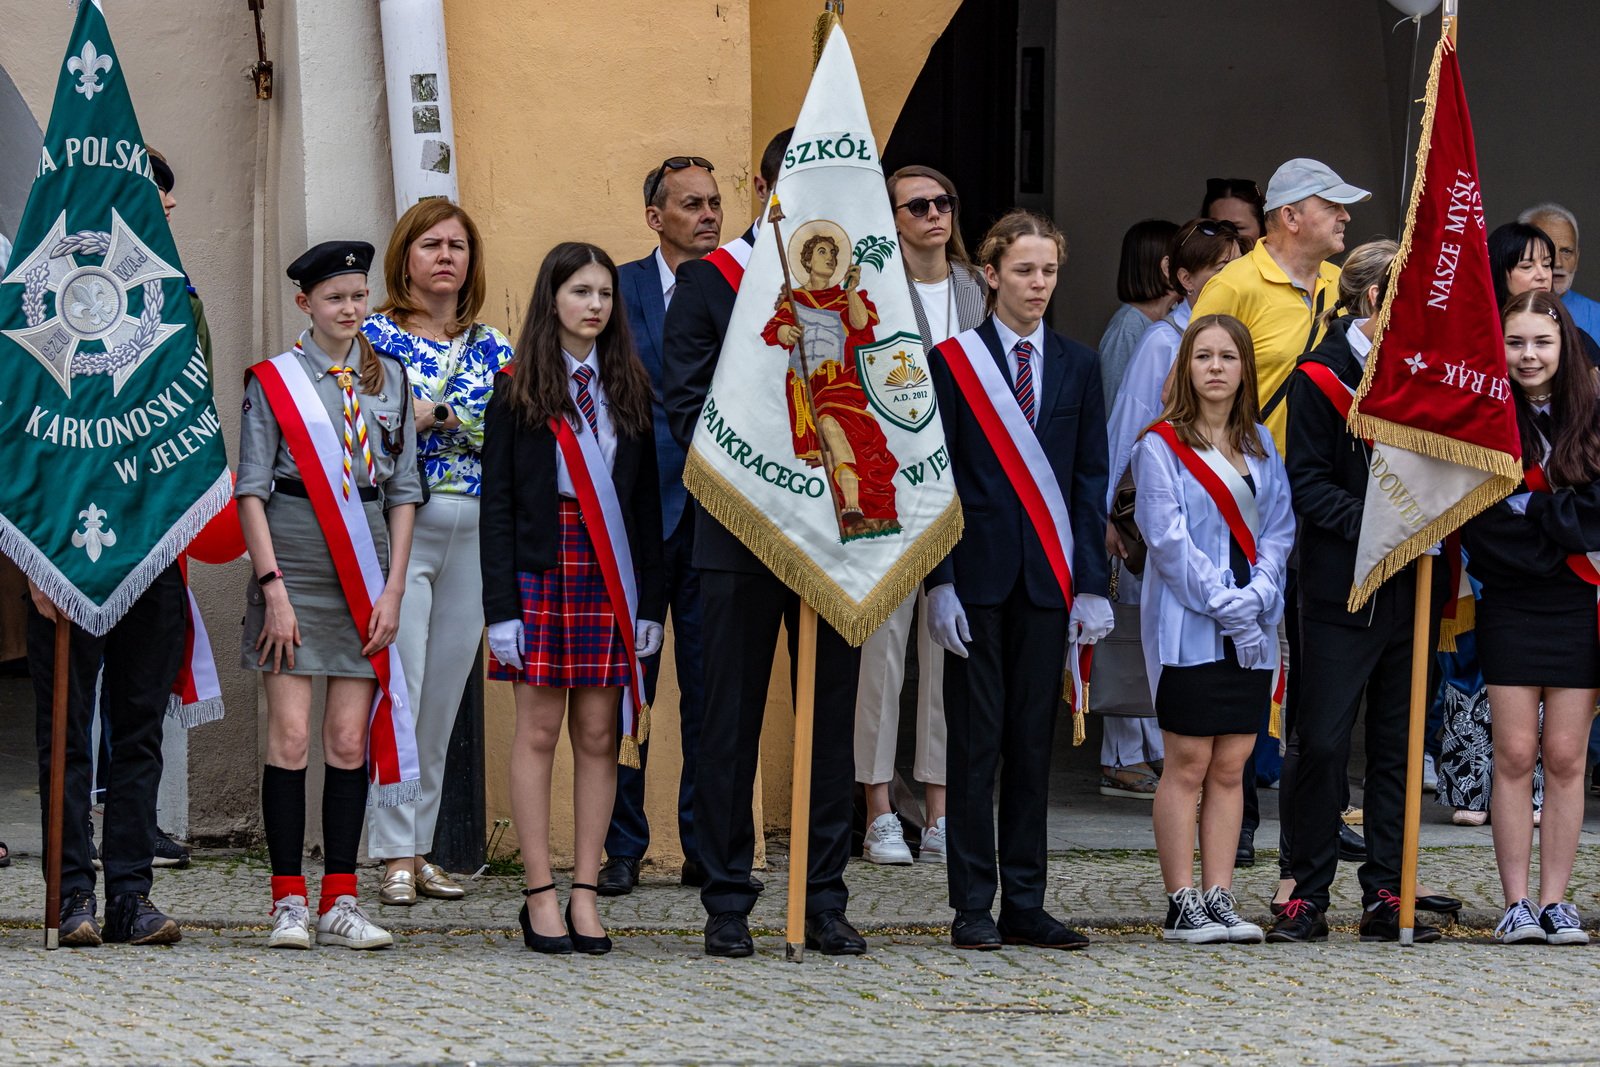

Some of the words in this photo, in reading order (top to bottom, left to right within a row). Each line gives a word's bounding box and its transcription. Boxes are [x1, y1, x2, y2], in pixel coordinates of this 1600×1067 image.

[784, 132, 872, 170] SZKÓŁ
[113, 246, 148, 281] WAJ
[1426, 241, 1462, 311] NASZE
[41, 328, 70, 361] CZU
[1439, 359, 1487, 394] RĄK
[893, 393, 911, 403] A.D.
[912, 390, 928, 400] 2012
[25, 381, 194, 448] KARKONOSKI
[703, 396, 825, 498] PANKRACEGO
[113, 456, 137, 484] W
[900, 461, 924, 487] W
